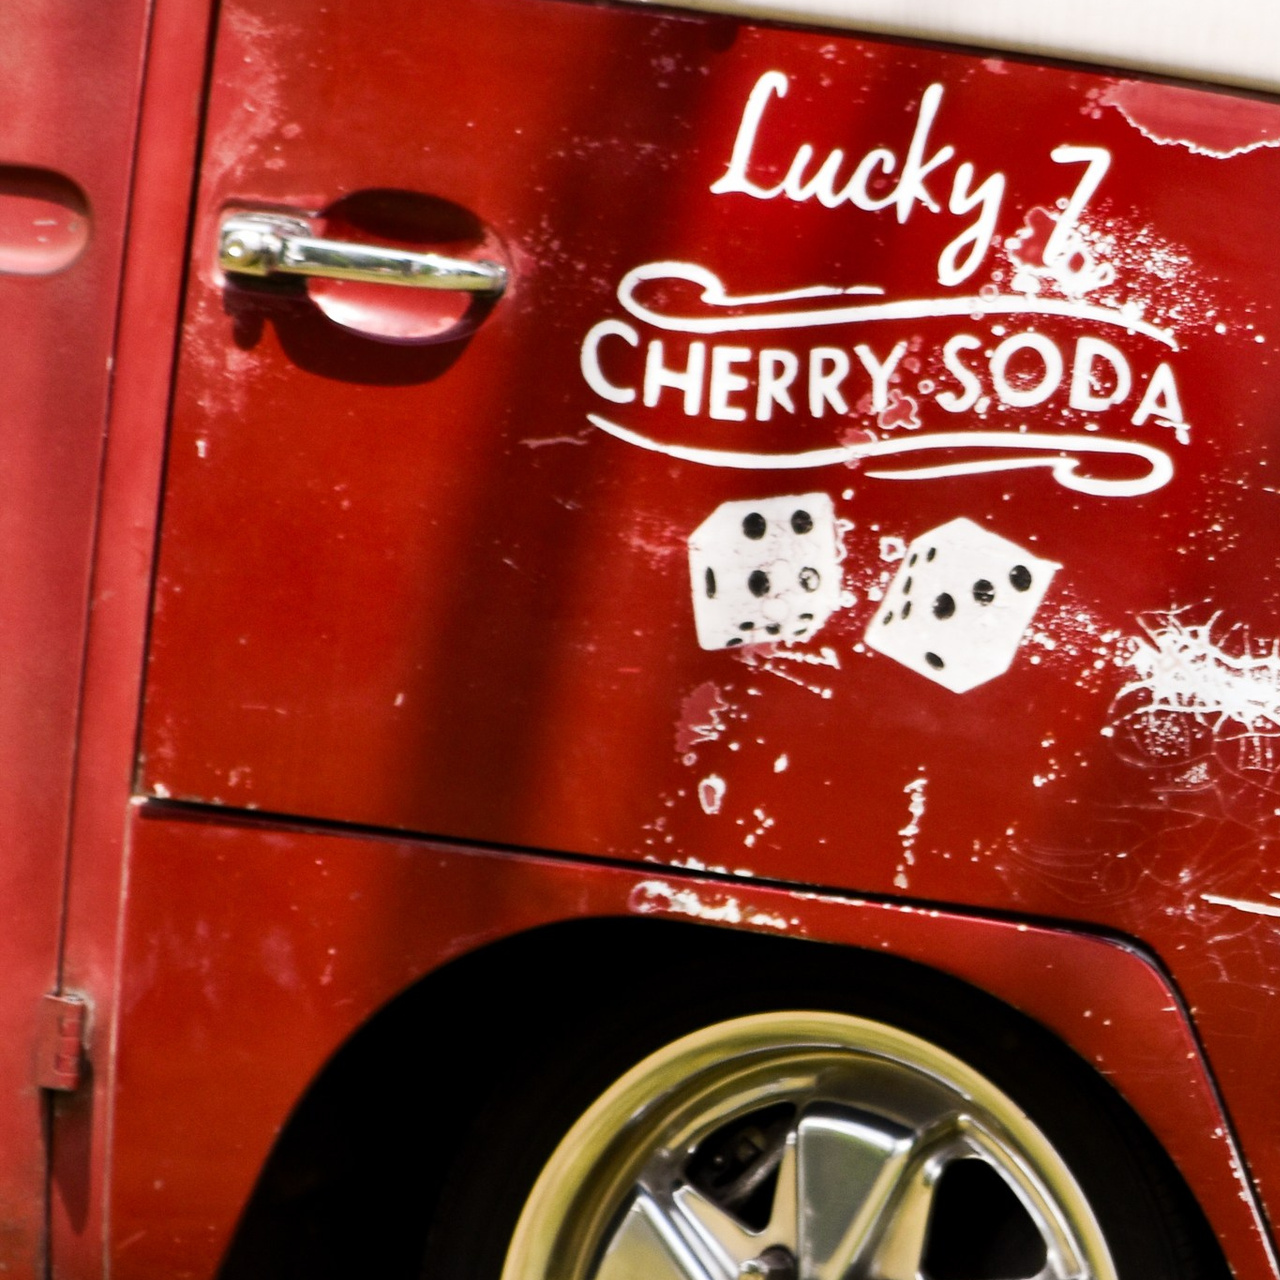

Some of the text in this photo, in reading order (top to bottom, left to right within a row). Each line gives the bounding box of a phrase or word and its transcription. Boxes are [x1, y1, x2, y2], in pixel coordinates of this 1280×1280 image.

[709, 70, 1111, 286] Lucky 7
[580, 319, 1190, 433] CHERRY SODA
